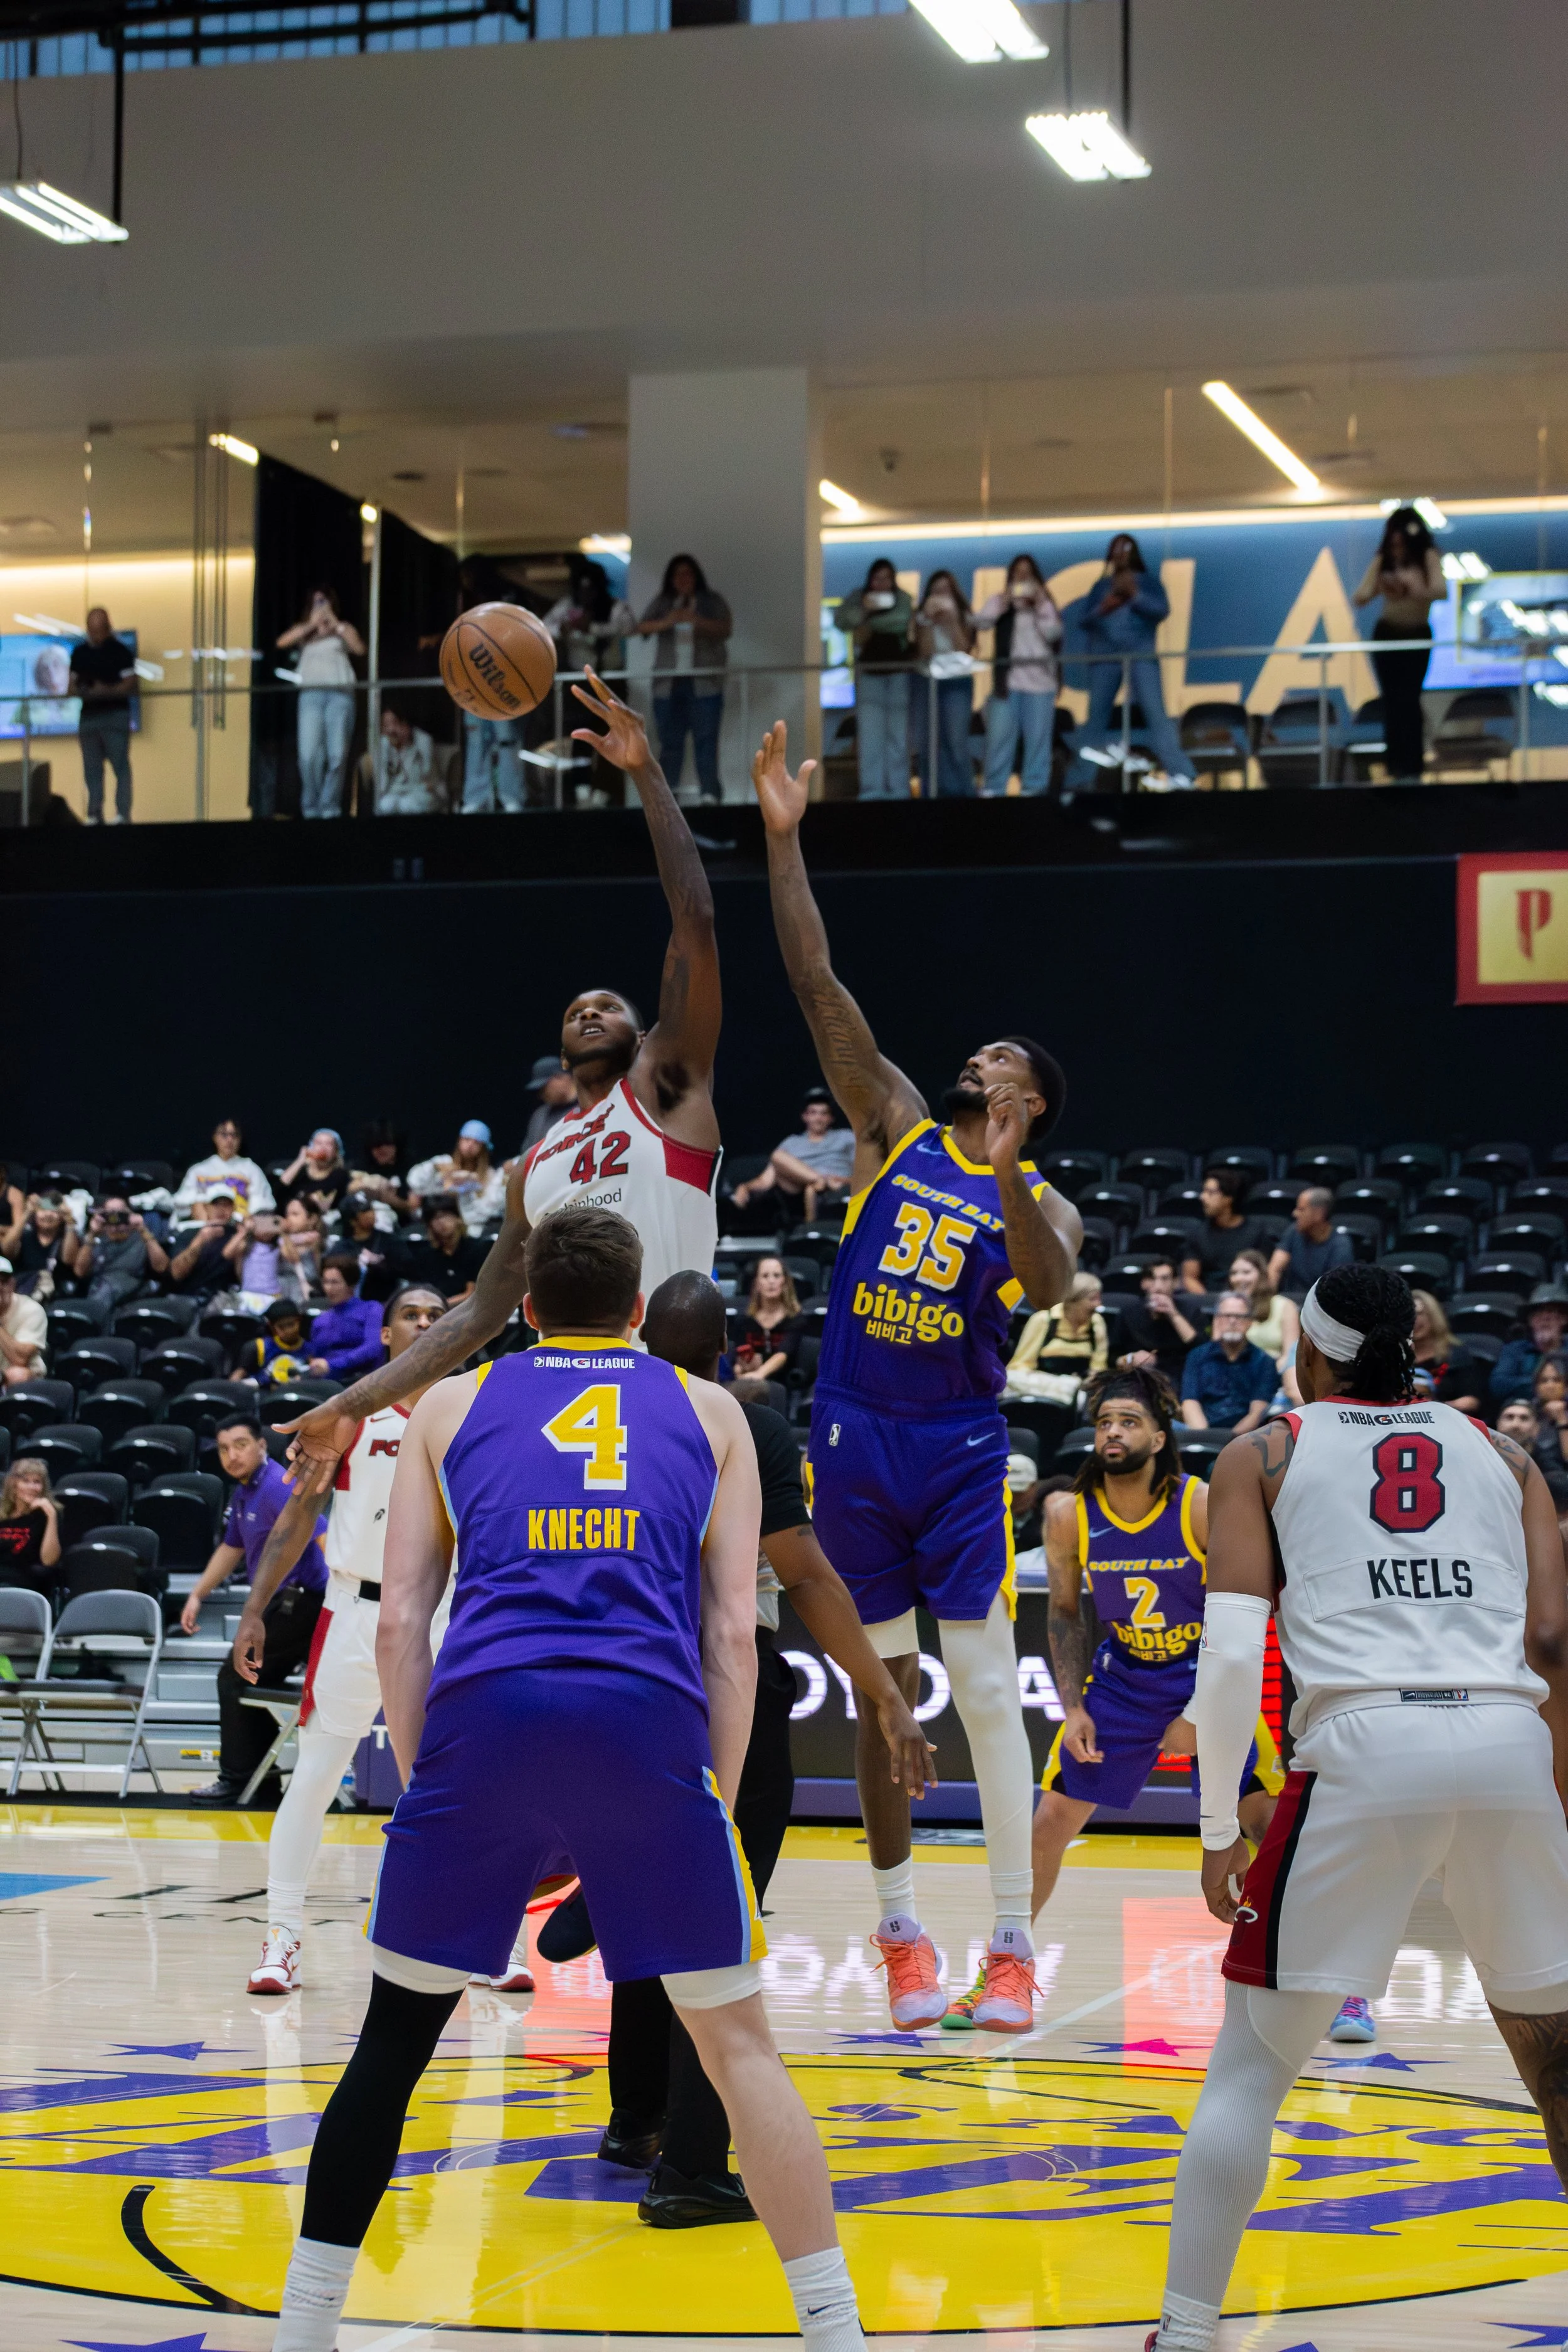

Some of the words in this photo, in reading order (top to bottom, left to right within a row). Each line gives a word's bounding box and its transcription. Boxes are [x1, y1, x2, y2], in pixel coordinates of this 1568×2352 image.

[469, 642, 522, 709] Wilson
[569, 1130, 632, 1185] 42
[891, 1174, 966, 1209] SOUTH
[960, 1203, 1005, 1232] BAY
[878, 1201, 977, 1292] 35
[852, 1282, 965, 1342] bibigo
[866, 1320, 913, 1345] 비비고
[545, 1356, 571, 1369] NBA
[571, 1357, 591, 1369] G
[592, 1358, 635, 1369] LEAGUE
[541, 1384, 627, 1490] 4
[1347, 1411, 1376, 1426] NBA
[1394, 1411, 1436, 1424] LEAGUE
[1369, 1431, 1446, 1534] 8
[528, 1508, 640, 1551] KNECHT
[1088, 1559, 1148, 1572] SOUTH
[1148, 1556, 1190, 1571] BAY
[1367, 1558, 1473, 1599] KEELS
[1123, 1577, 1167, 1628] 2
[1111, 1620, 1202, 1655] bibigo
[780, 1650, 1066, 1722] OYOA
